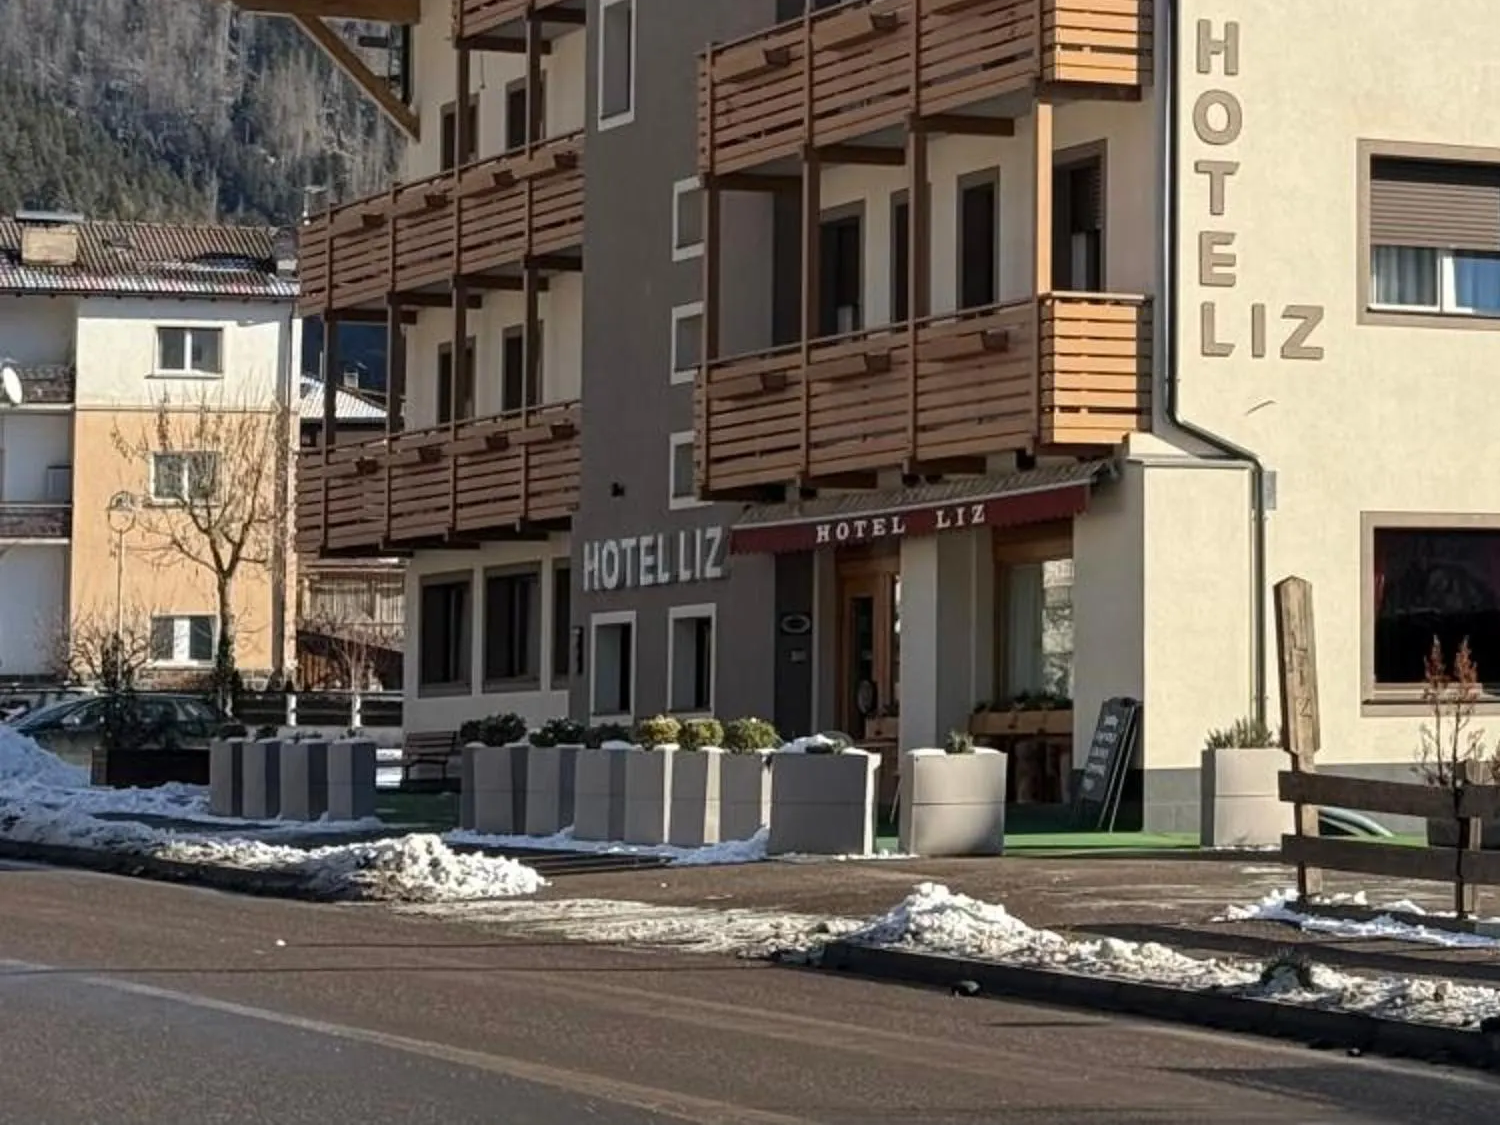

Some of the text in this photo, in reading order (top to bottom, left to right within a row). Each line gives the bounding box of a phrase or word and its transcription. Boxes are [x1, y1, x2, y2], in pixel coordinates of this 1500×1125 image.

[1201, 301, 1325, 360] LIZ
[816, 504, 986, 544] HOTEL LIZ
[583, 526, 723, 592] HOTEL LIZ
